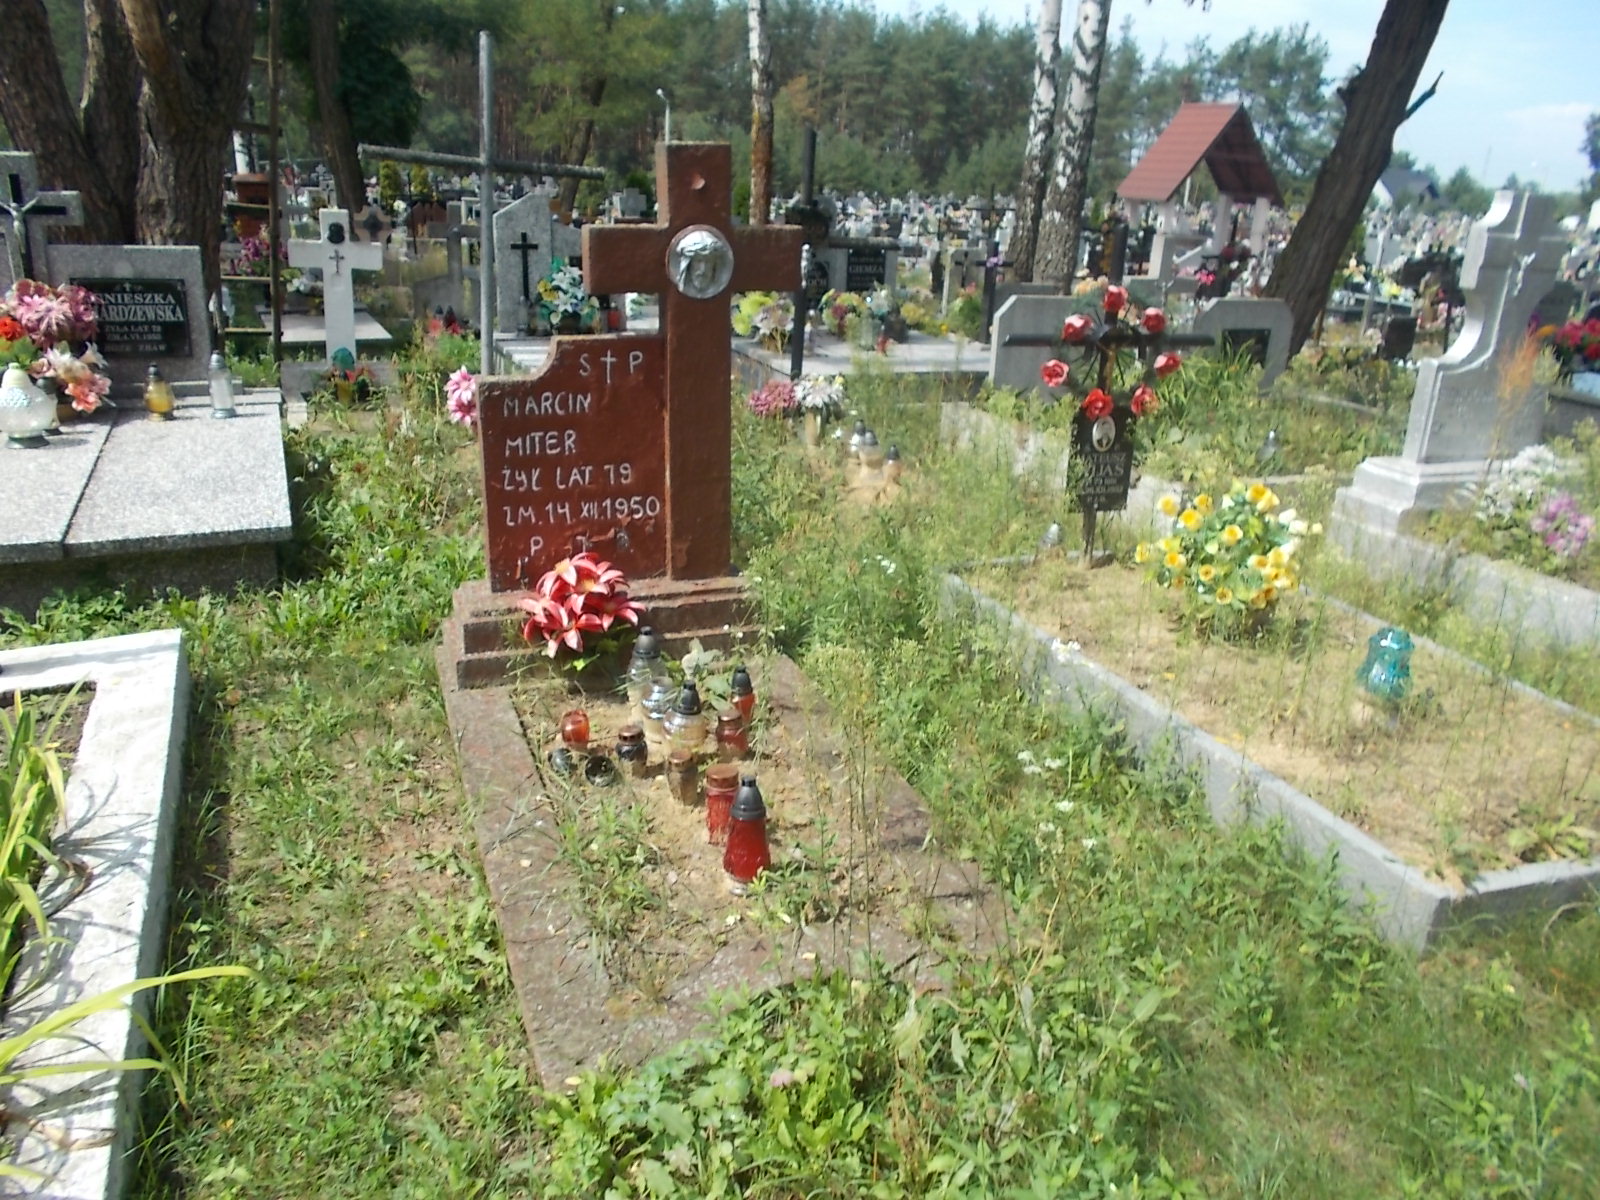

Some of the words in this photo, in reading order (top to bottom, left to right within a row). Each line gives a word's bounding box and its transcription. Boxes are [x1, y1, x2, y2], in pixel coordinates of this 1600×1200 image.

[628, 349, 644, 375] P
[503, 391, 592, 417] MARCIN
[504, 429, 577, 458] MITER
[555, 465, 593, 490] LAT
